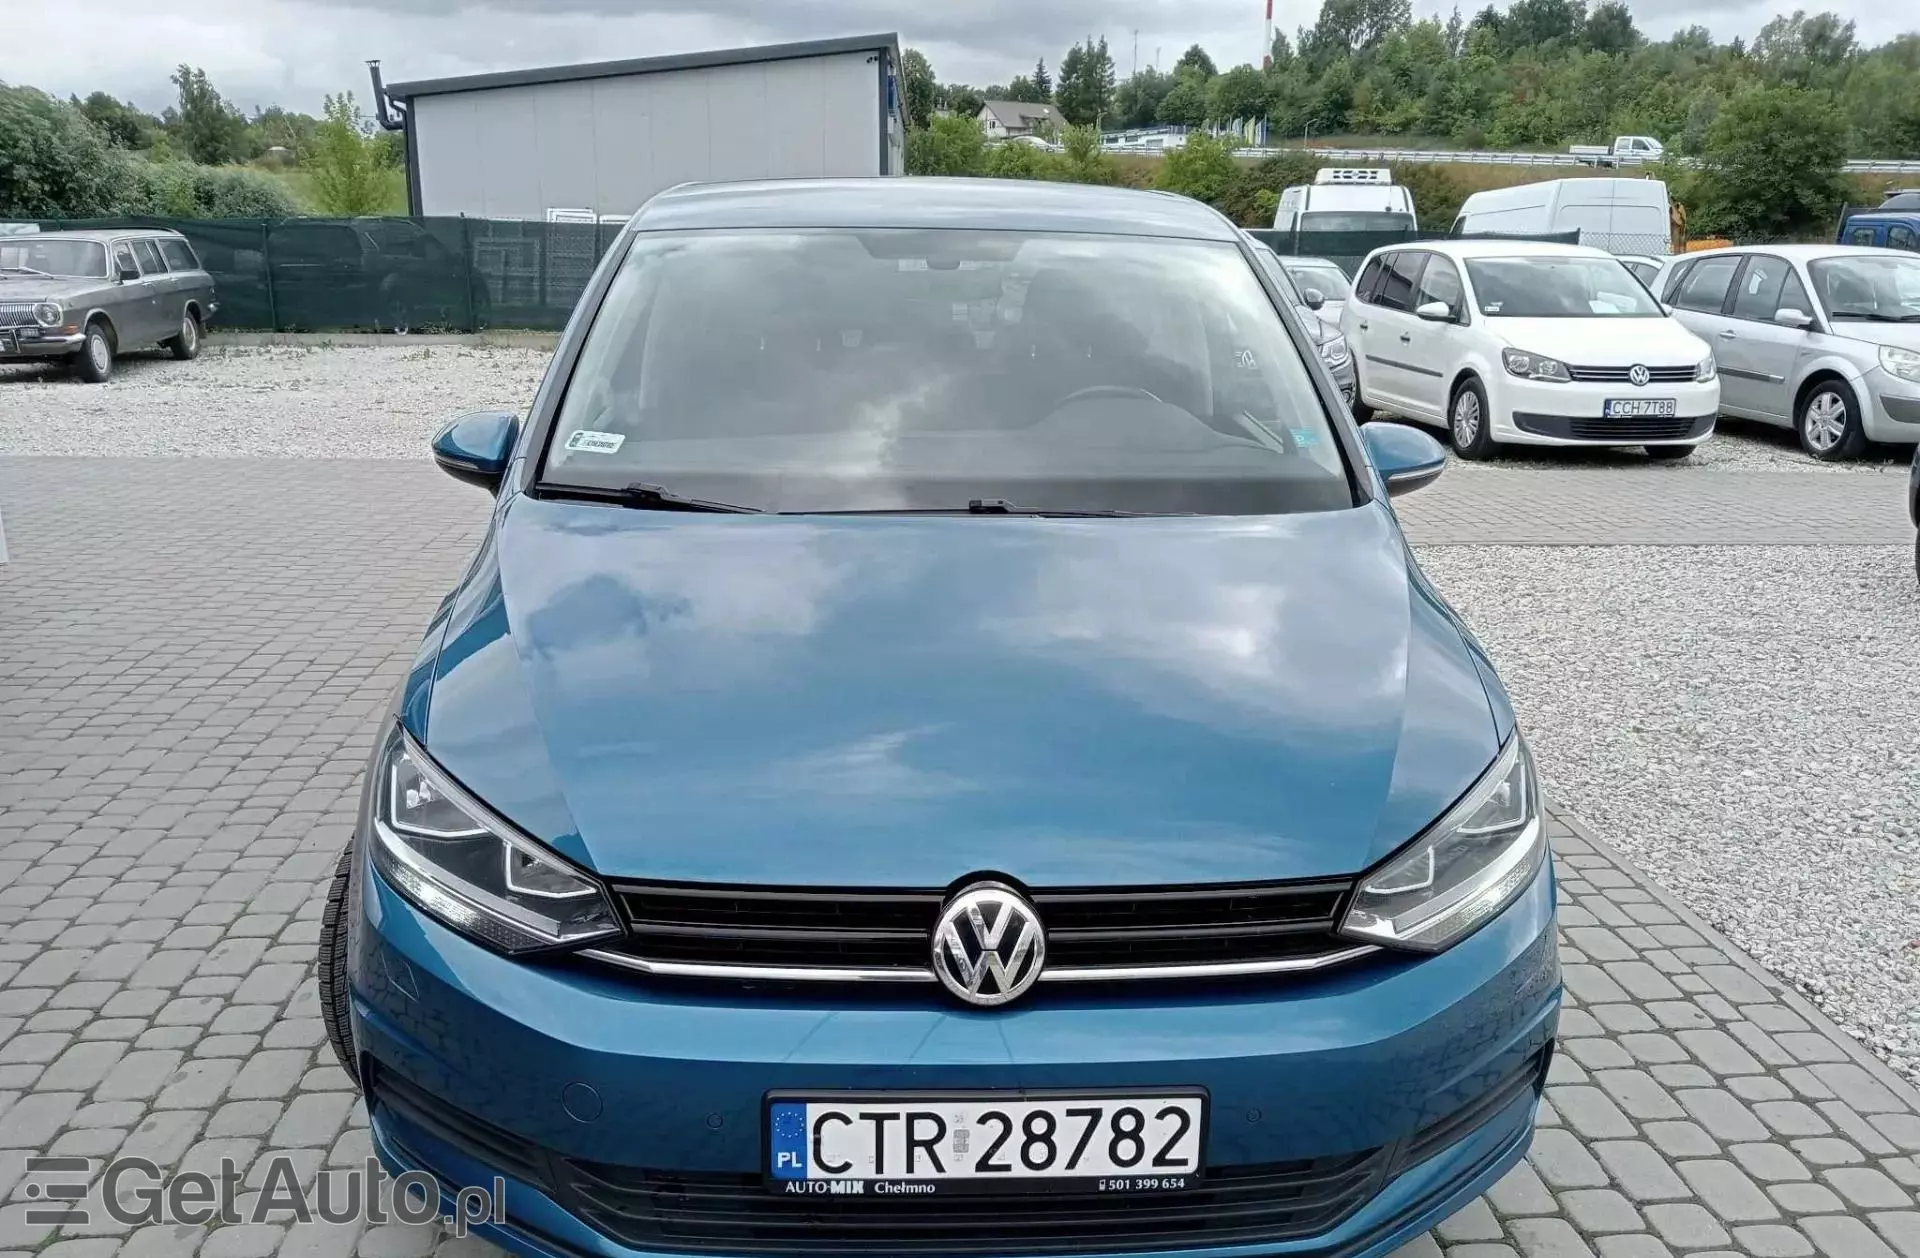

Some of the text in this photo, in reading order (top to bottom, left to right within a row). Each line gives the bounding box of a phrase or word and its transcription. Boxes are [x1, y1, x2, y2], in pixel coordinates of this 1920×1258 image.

[1613, 402, 1639, 414] CCH
[812, 1105, 1191, 1174] CTR 28782
[777, 1152, 802, 1168] PL
[1108, 1178, 1185, 1190] 501 399 654
